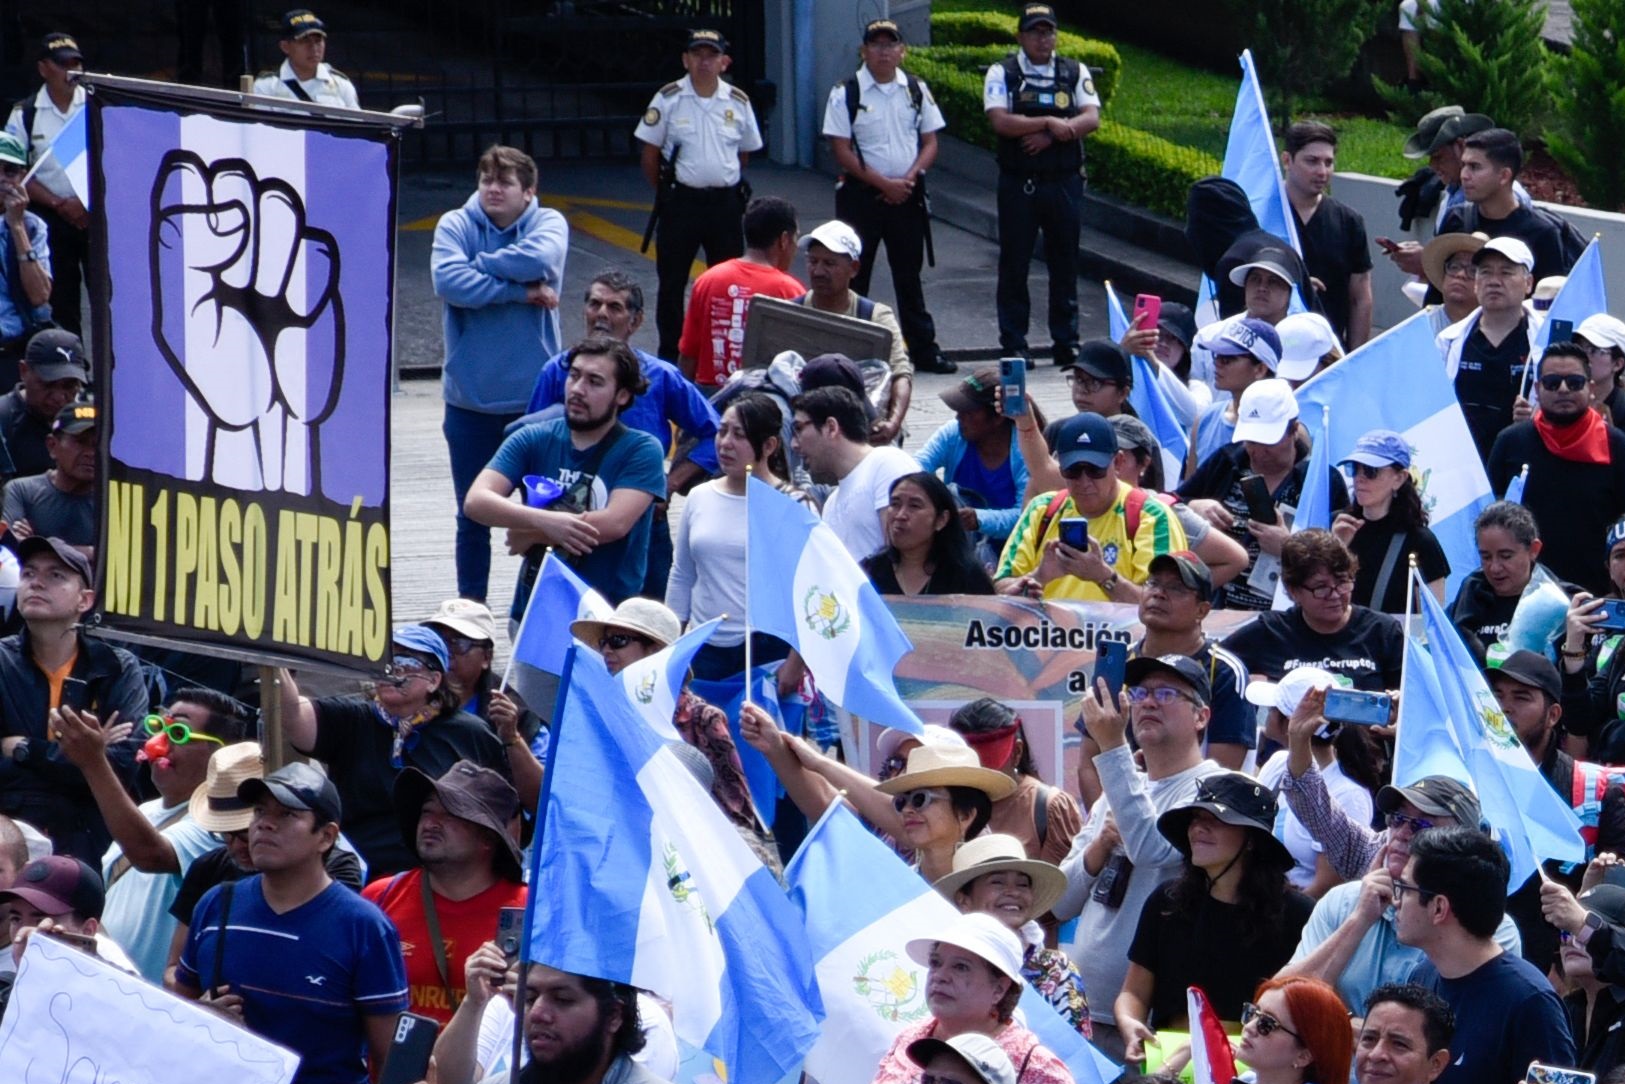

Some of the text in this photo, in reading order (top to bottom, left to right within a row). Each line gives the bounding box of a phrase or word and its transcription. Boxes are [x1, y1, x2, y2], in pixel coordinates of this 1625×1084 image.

[105, 480, 388, 662] NI 1 PASO ATRÁS
